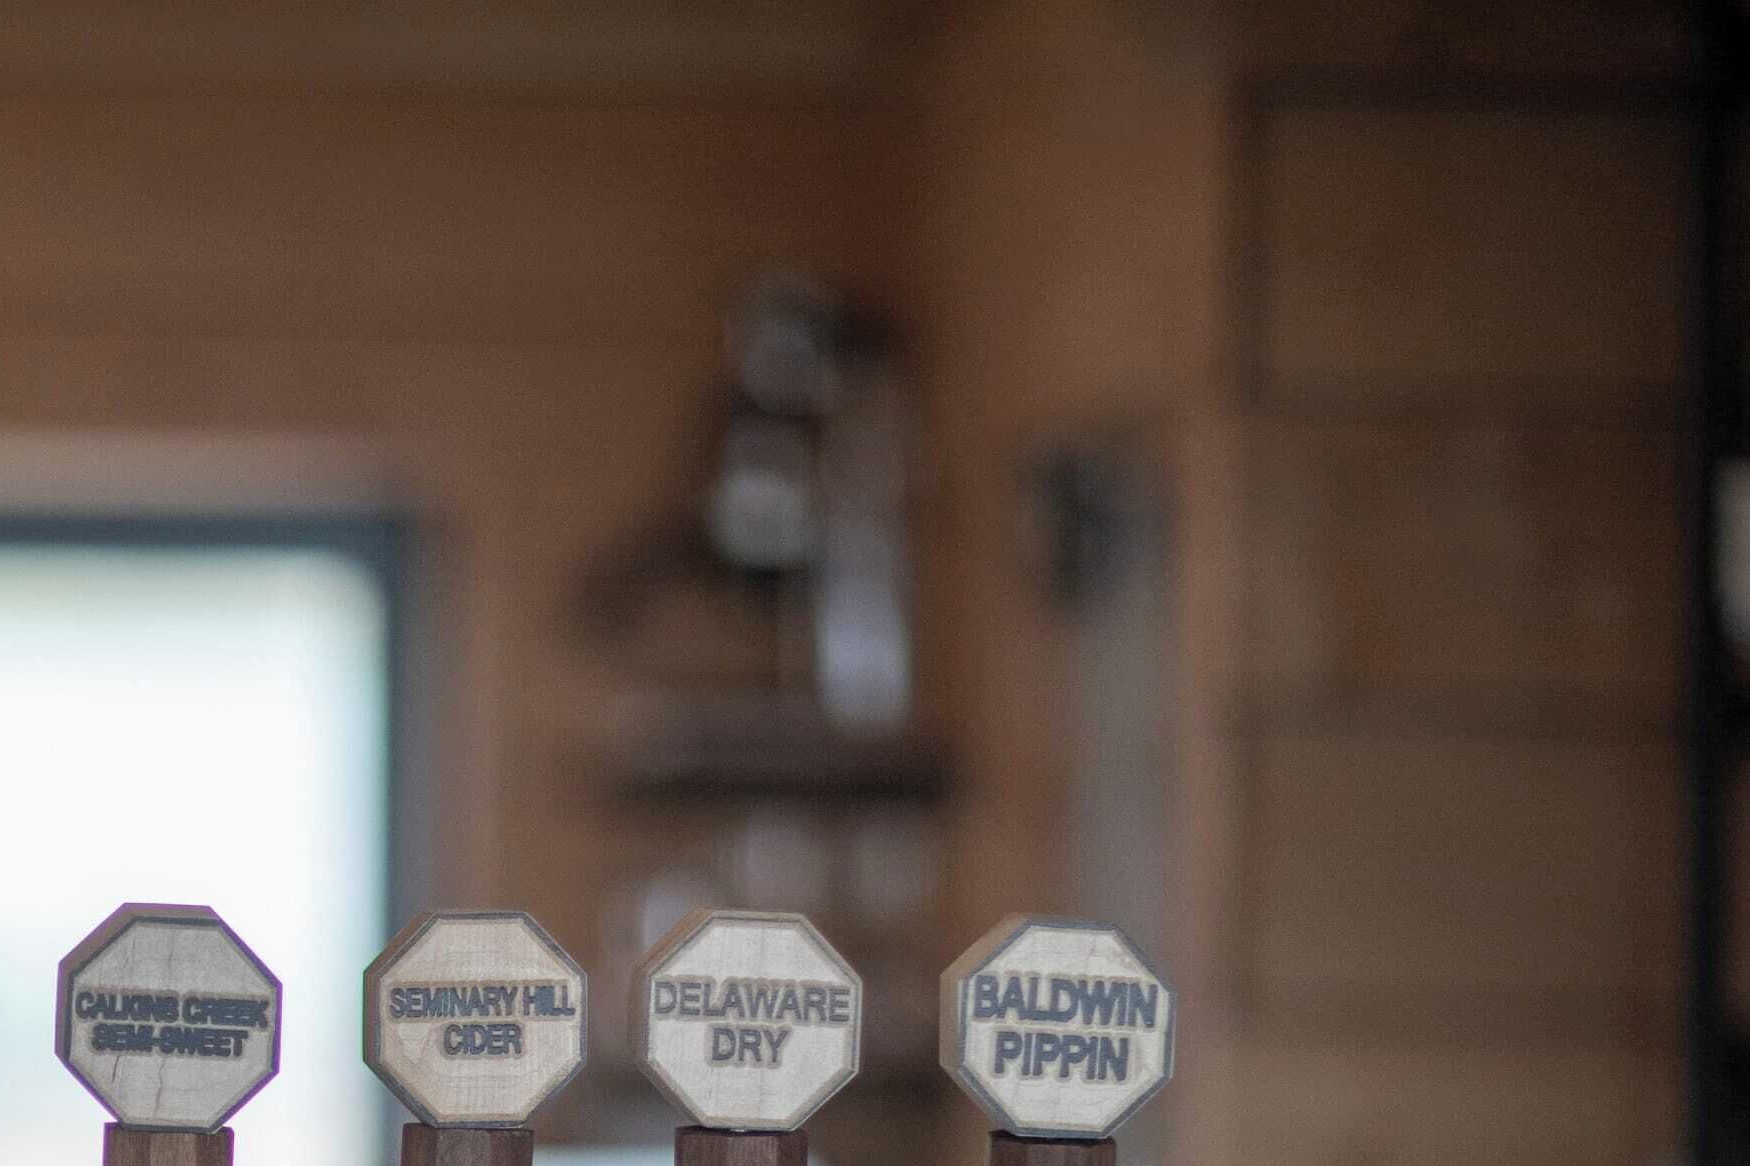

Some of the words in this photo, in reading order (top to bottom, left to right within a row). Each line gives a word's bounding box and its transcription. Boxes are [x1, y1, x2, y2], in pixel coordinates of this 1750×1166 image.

[182, 997, 270, 1029] CREEK
[389, 986, 518, 1018] SEMINARY
[522, 985, 576, 1017] HILL
[654, 980, 850, 1023] DELAWARE
[974, 974, 1158, 1029] BALDWIN
[91, 1022, 249, 1058] SEMI-SWEET
[443, 1023, 523, 1055] CIDER
[711, 1026, 791, 1064] DRY
[993, 1030, 1129, 1081] PIPPIN
